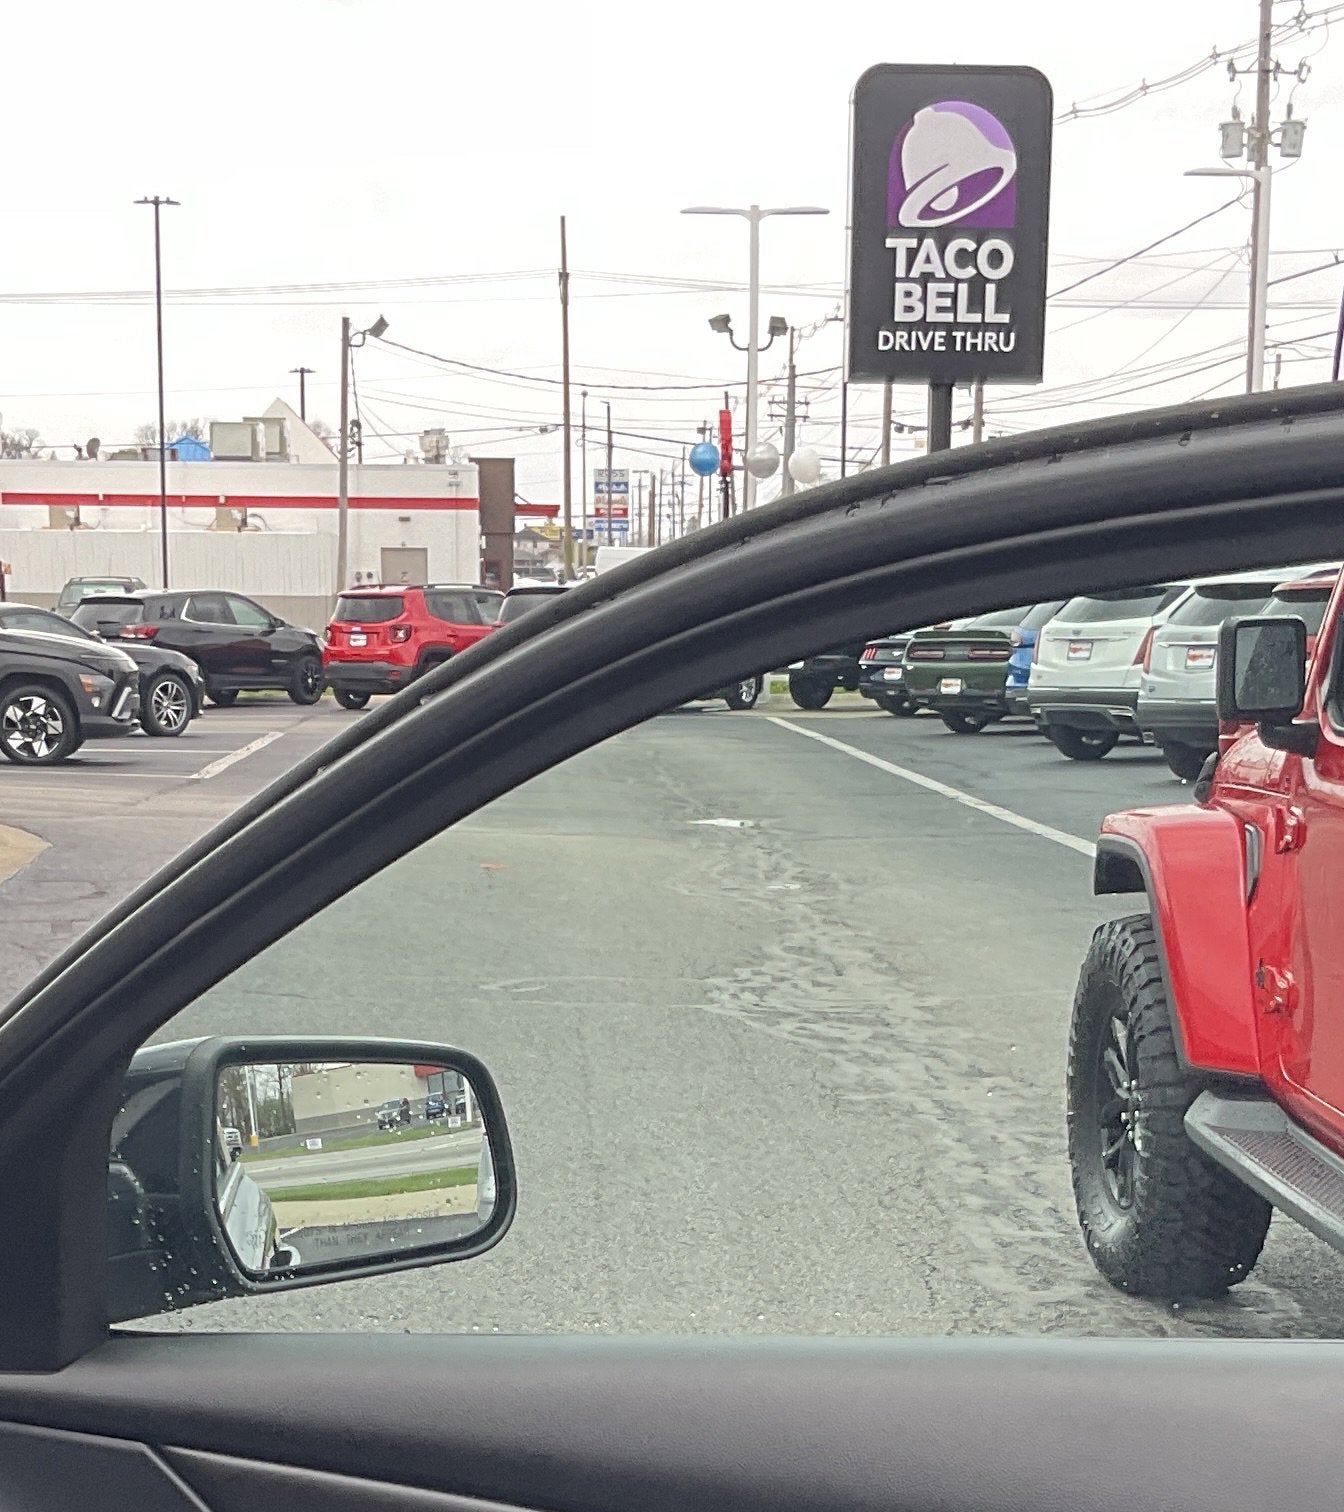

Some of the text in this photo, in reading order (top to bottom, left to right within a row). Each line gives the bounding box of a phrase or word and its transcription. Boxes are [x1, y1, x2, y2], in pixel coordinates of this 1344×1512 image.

[885, 238, 1015, 280] TACO
[894, 282, 1011, 324] BELL
[877, 330, 1016, 352] DRIVE THRU
